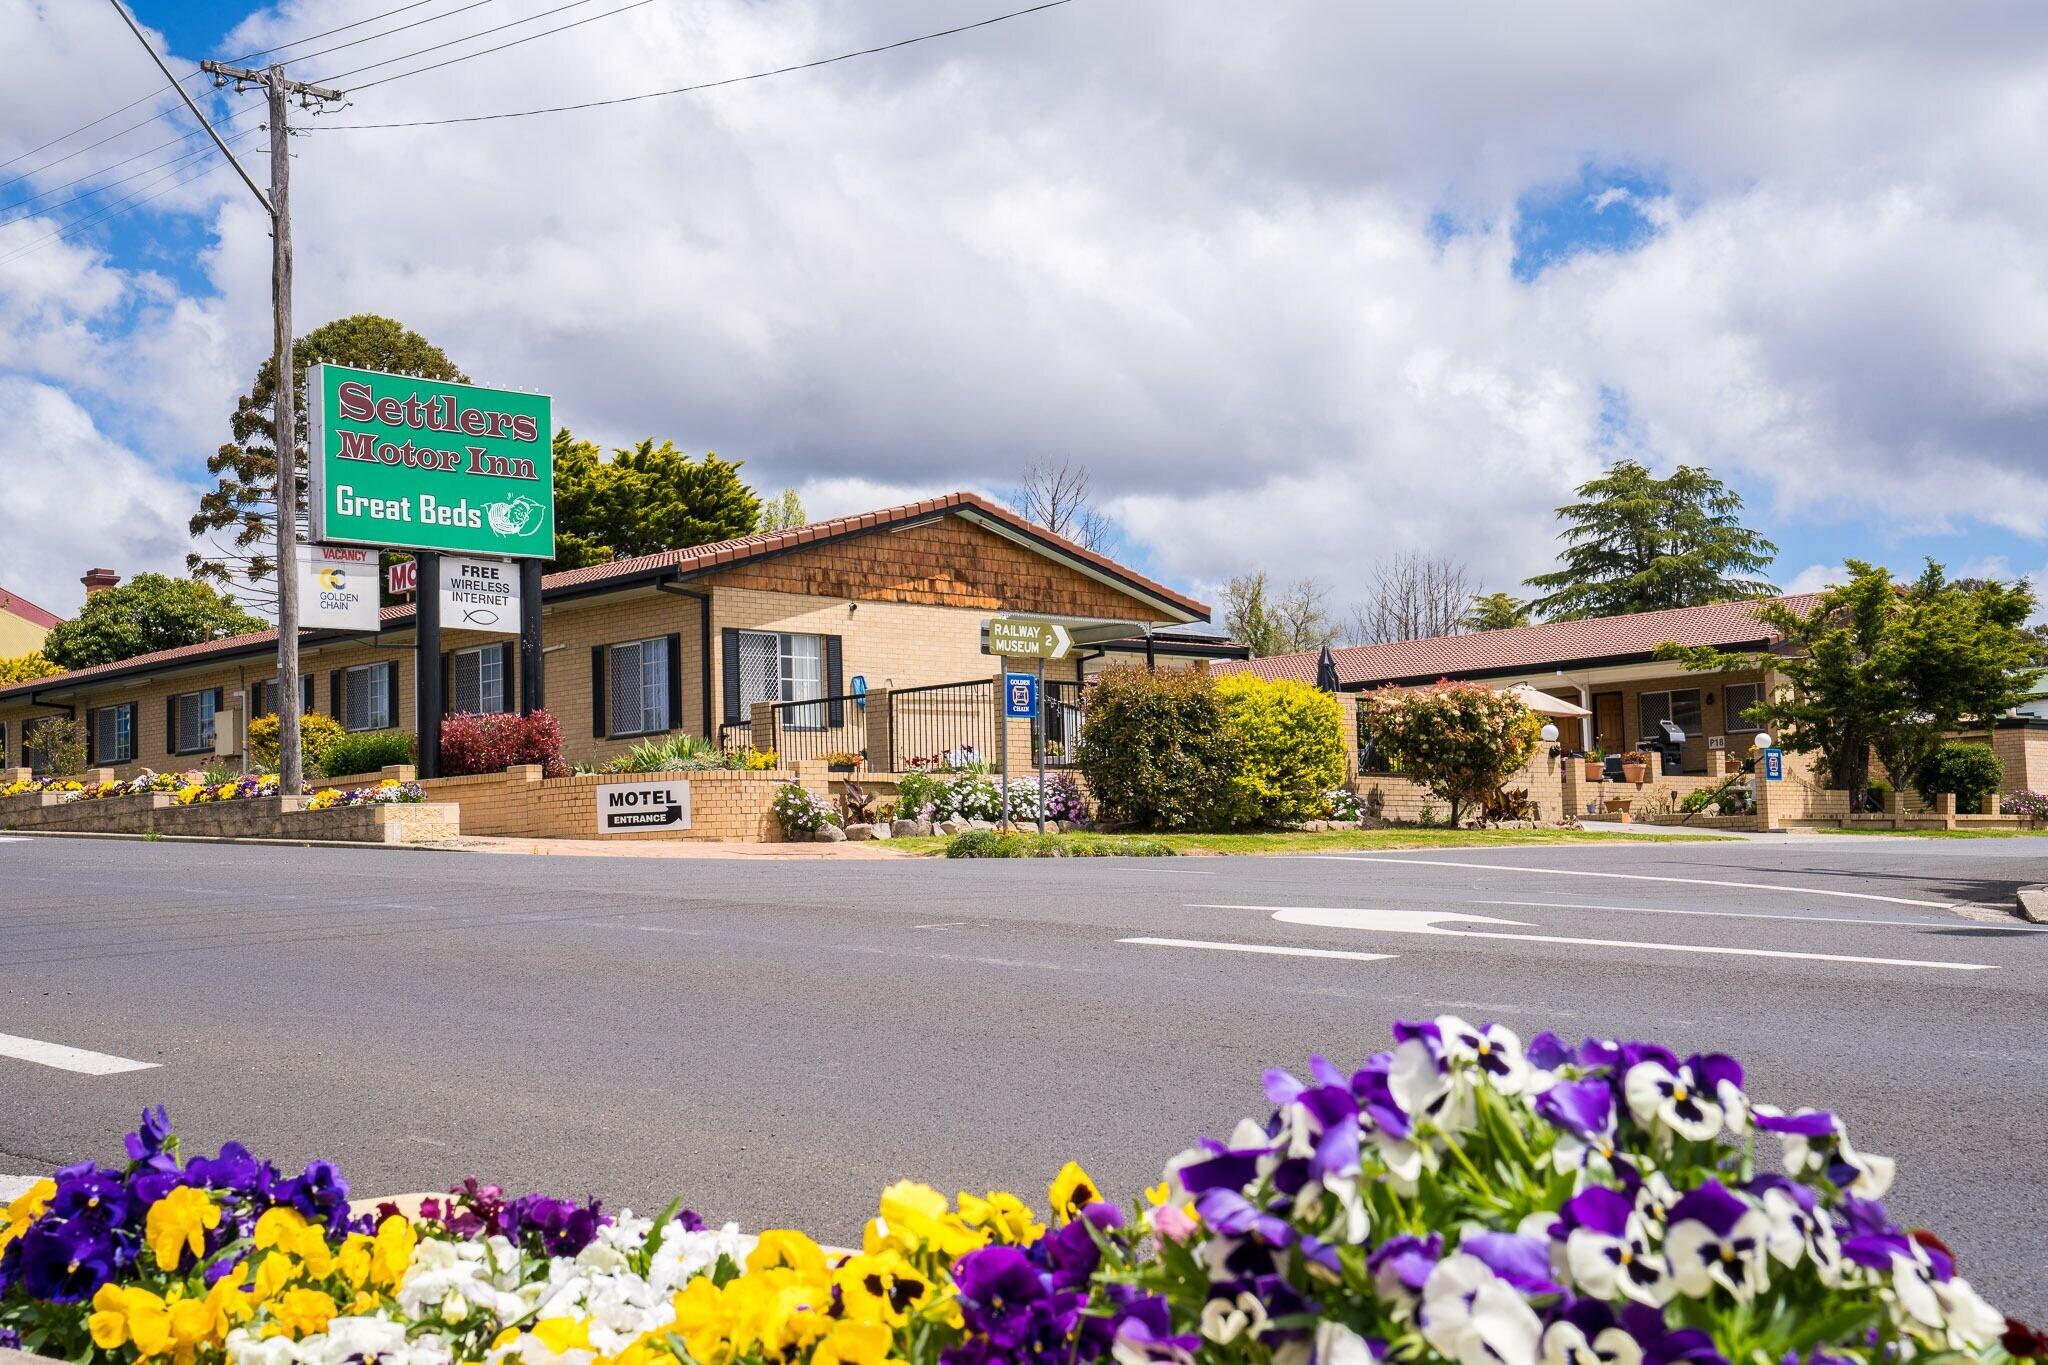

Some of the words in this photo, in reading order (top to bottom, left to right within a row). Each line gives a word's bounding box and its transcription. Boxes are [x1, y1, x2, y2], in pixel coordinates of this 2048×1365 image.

[338, 381, 538, 442] Settlers
[335, 429, 460, 472] Motor
[465, 446, 539, 480] Inn
[336, 485, 411, 522] Great
[420, 494, 482, 529] Beds
[322, 548, 367, 562] VACANCY
[461, 564, 500, 580] FREE
[450, 577, 510, 594] WIRELESS
[319, 591, 359, 602] GOLDEN
[452, 591, 509, 606] INTERNET
[320, 600, 349, 611] CHAIN
[994, 624, 1040, 638] RAILWAY
[996, 639, 1039, 653] MUSEUM
[1045, 635, 1053, 646] 2
[609, 790, 677, 806] MOTEL
[614, 814, 667, 824] ENTRANCE
